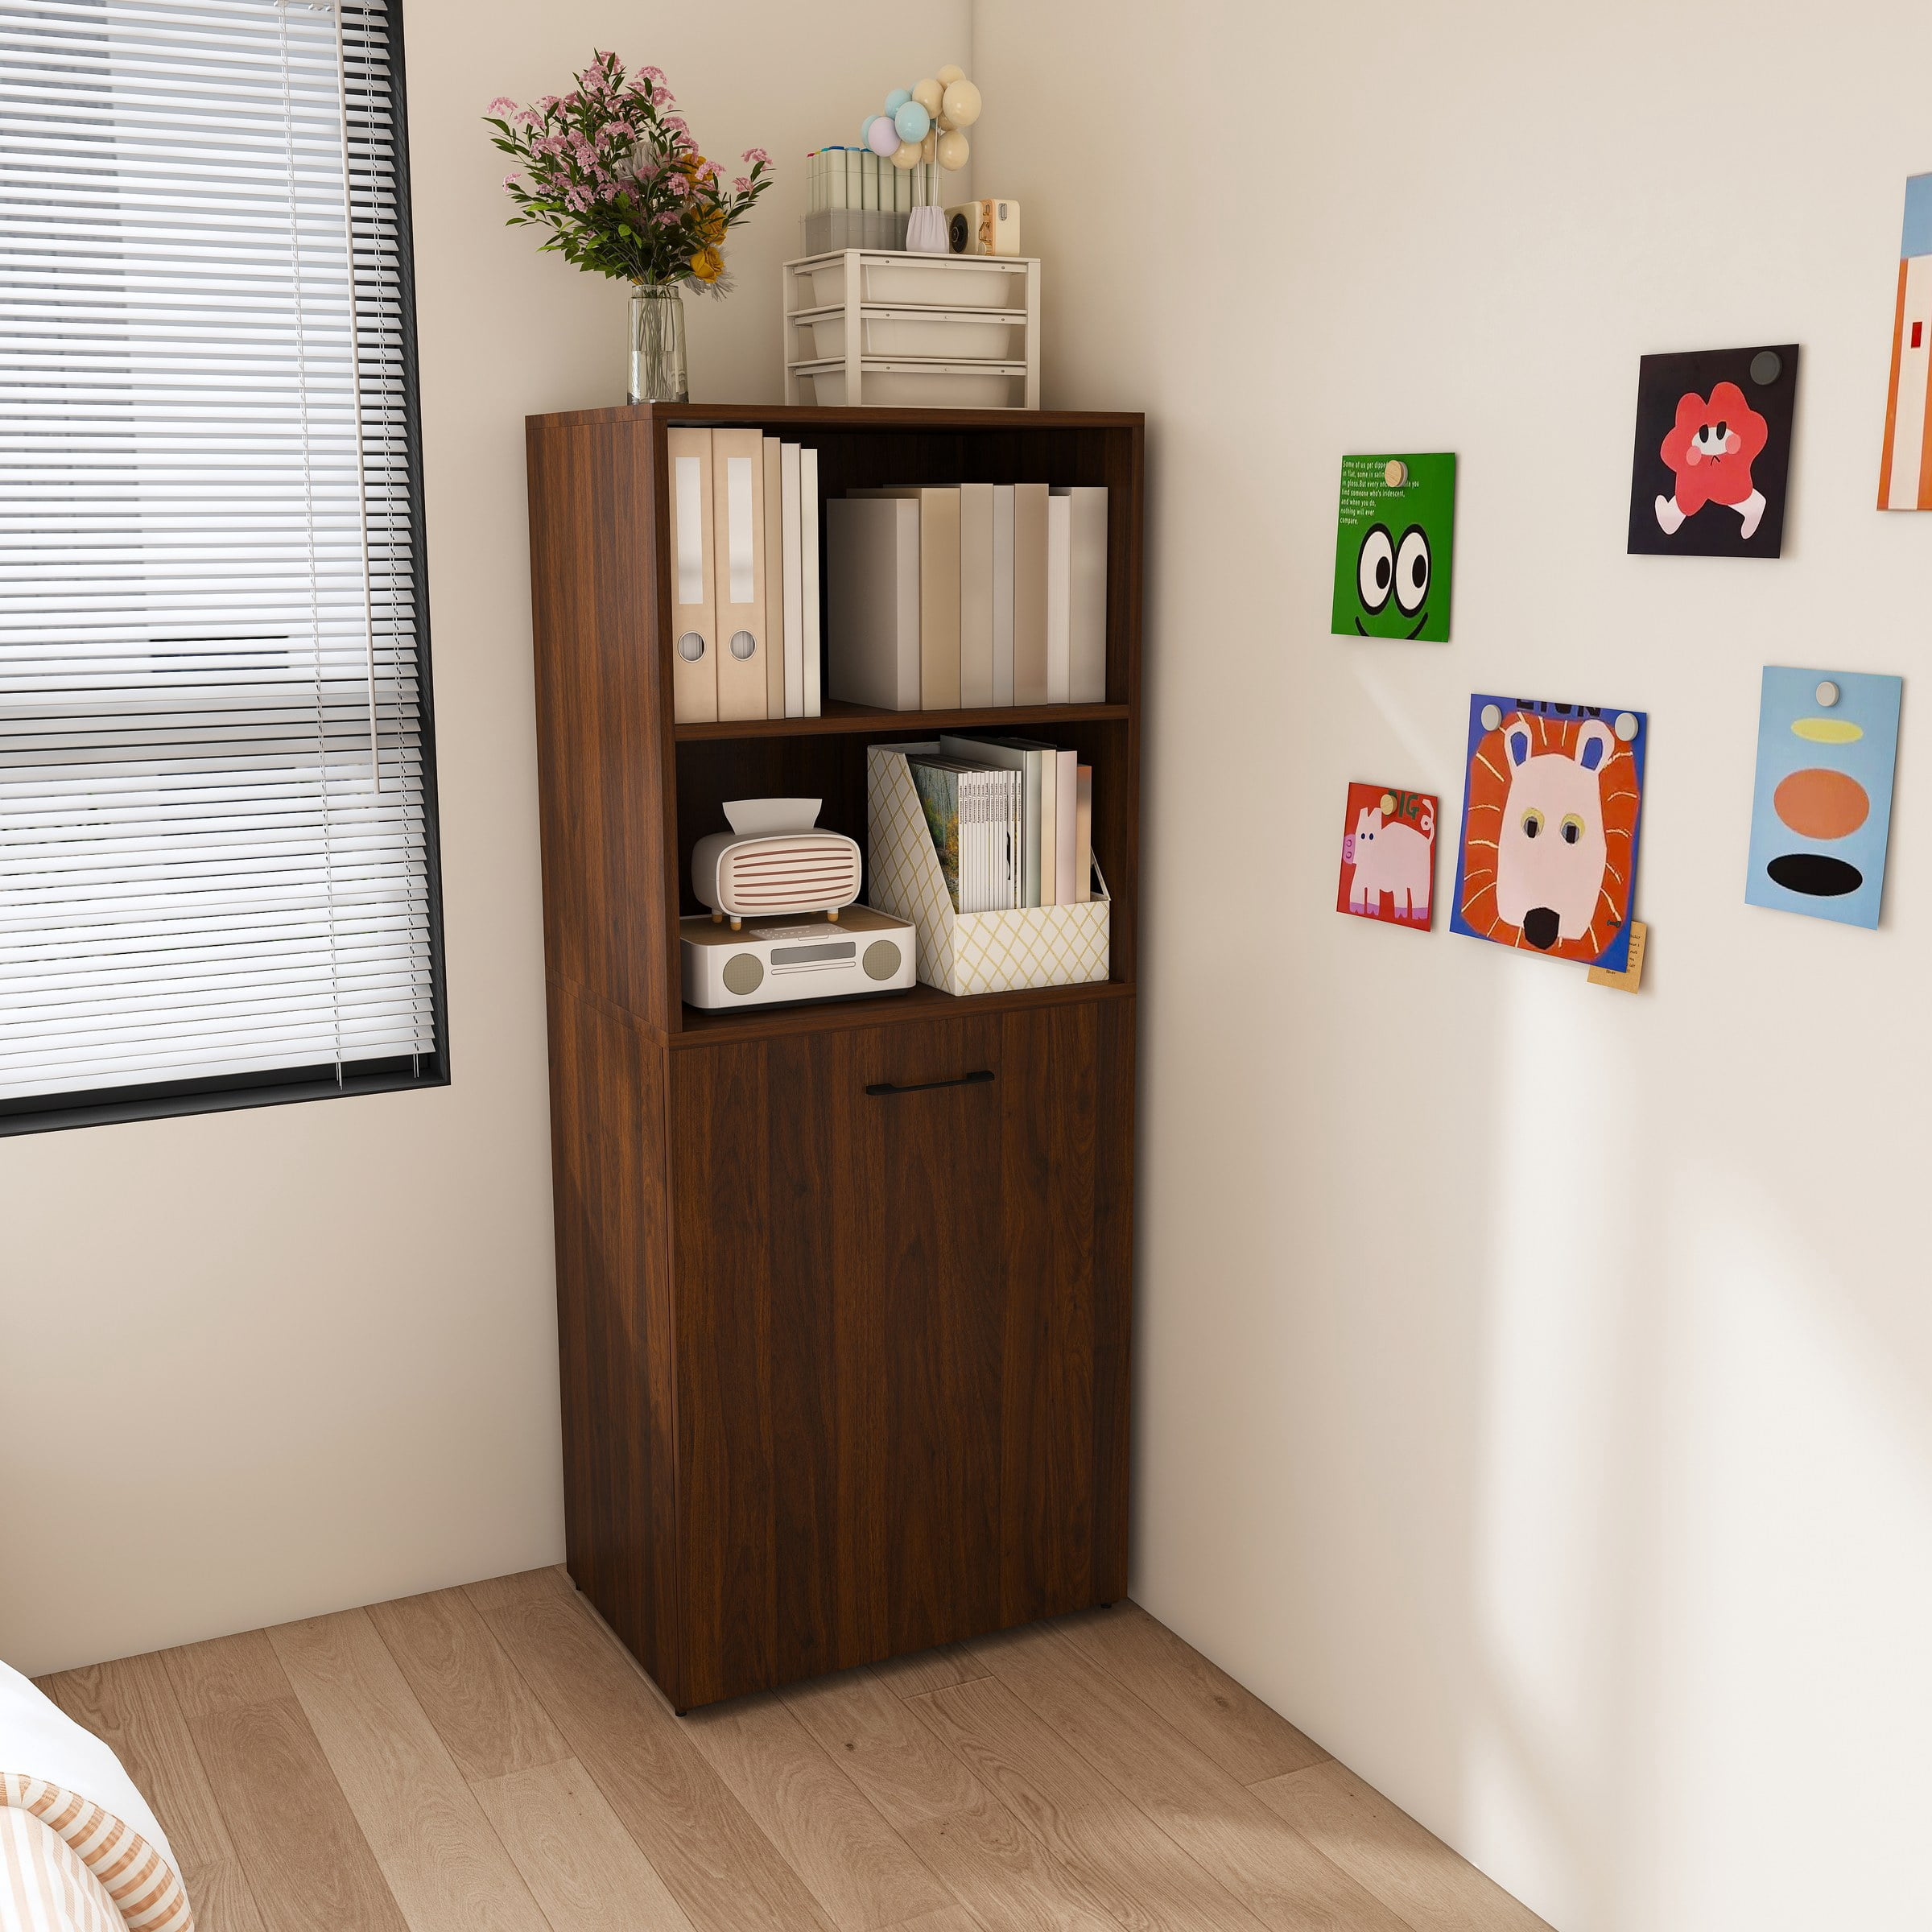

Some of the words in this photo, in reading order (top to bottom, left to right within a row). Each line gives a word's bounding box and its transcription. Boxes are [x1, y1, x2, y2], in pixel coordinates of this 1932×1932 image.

[1368, 481, 1378, 489] every
[1369, 489, 1381, 497] who's
[1382, 489, 1405, 497] iridescent,
[1340, 508, 1356, 516] nothing
[1340, 517, 1359, 525] compare.
[1387, 790, 1419, 820] IG
